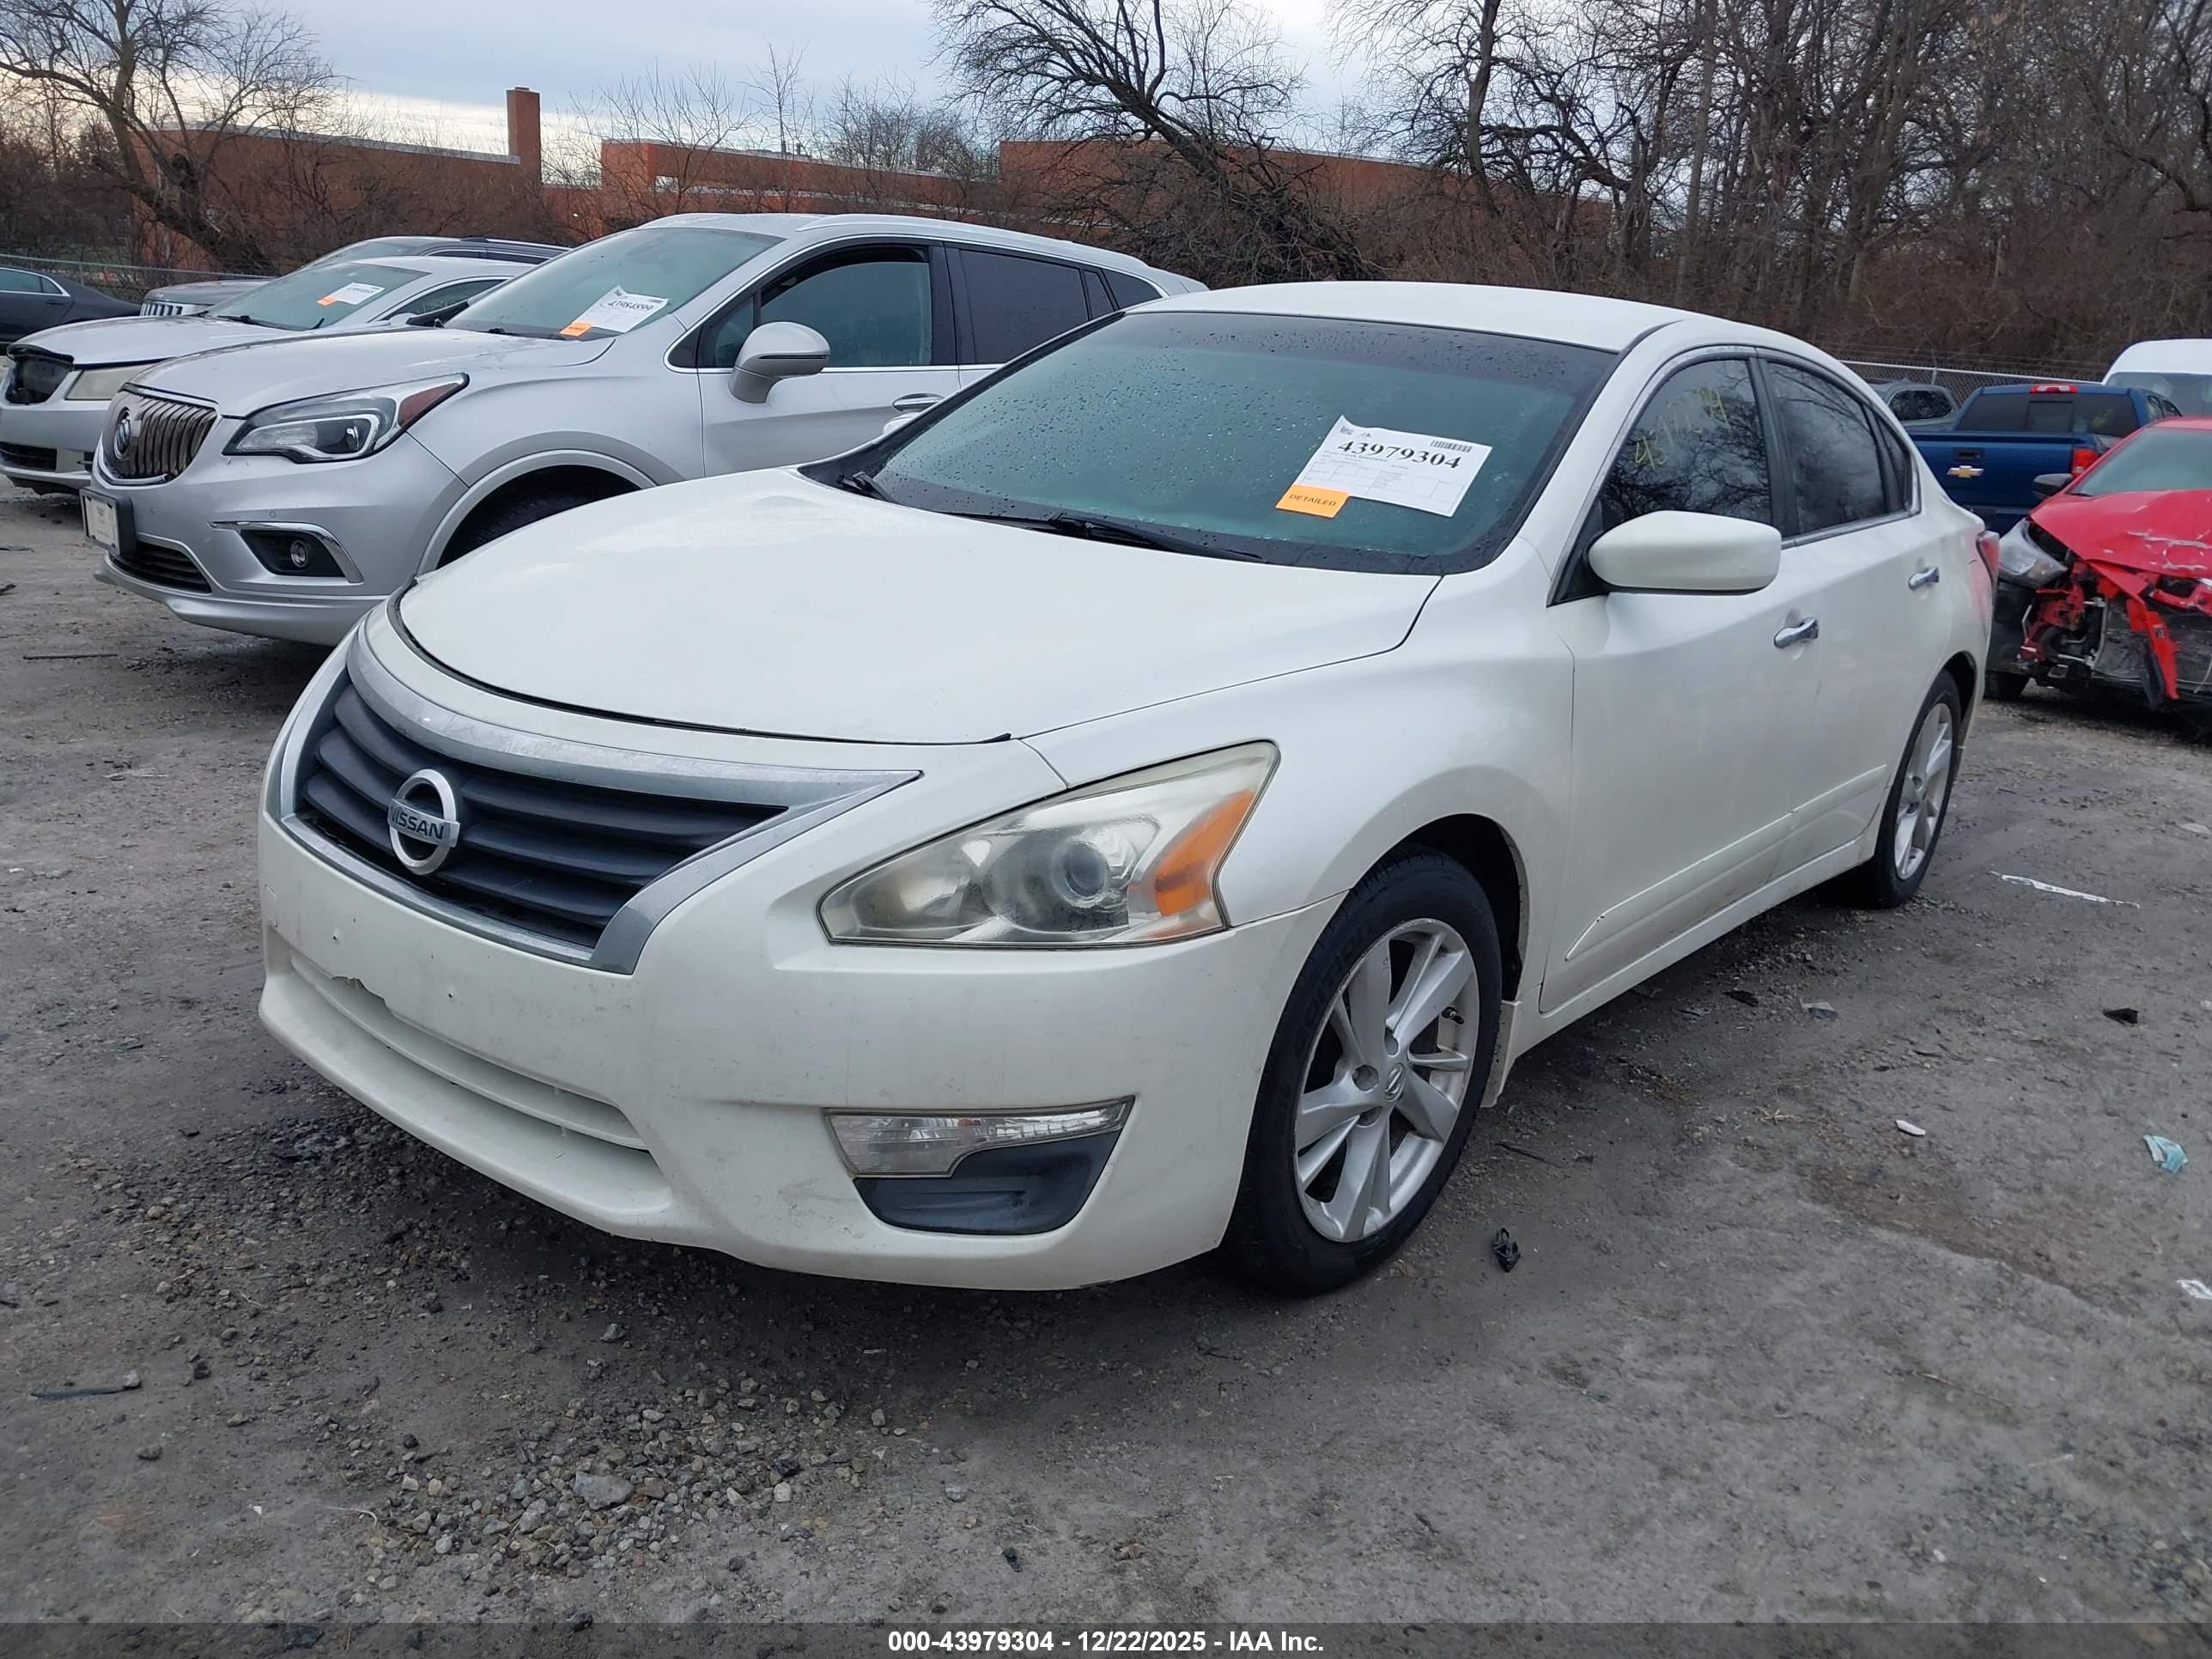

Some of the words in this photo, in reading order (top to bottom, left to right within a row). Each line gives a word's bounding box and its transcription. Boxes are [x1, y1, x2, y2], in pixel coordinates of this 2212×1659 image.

[1338, 441, 1462, 469] 43979304
[1288, 494, 1337, 507] DETAILED
[390, 805, 445, 840] NISSAN
